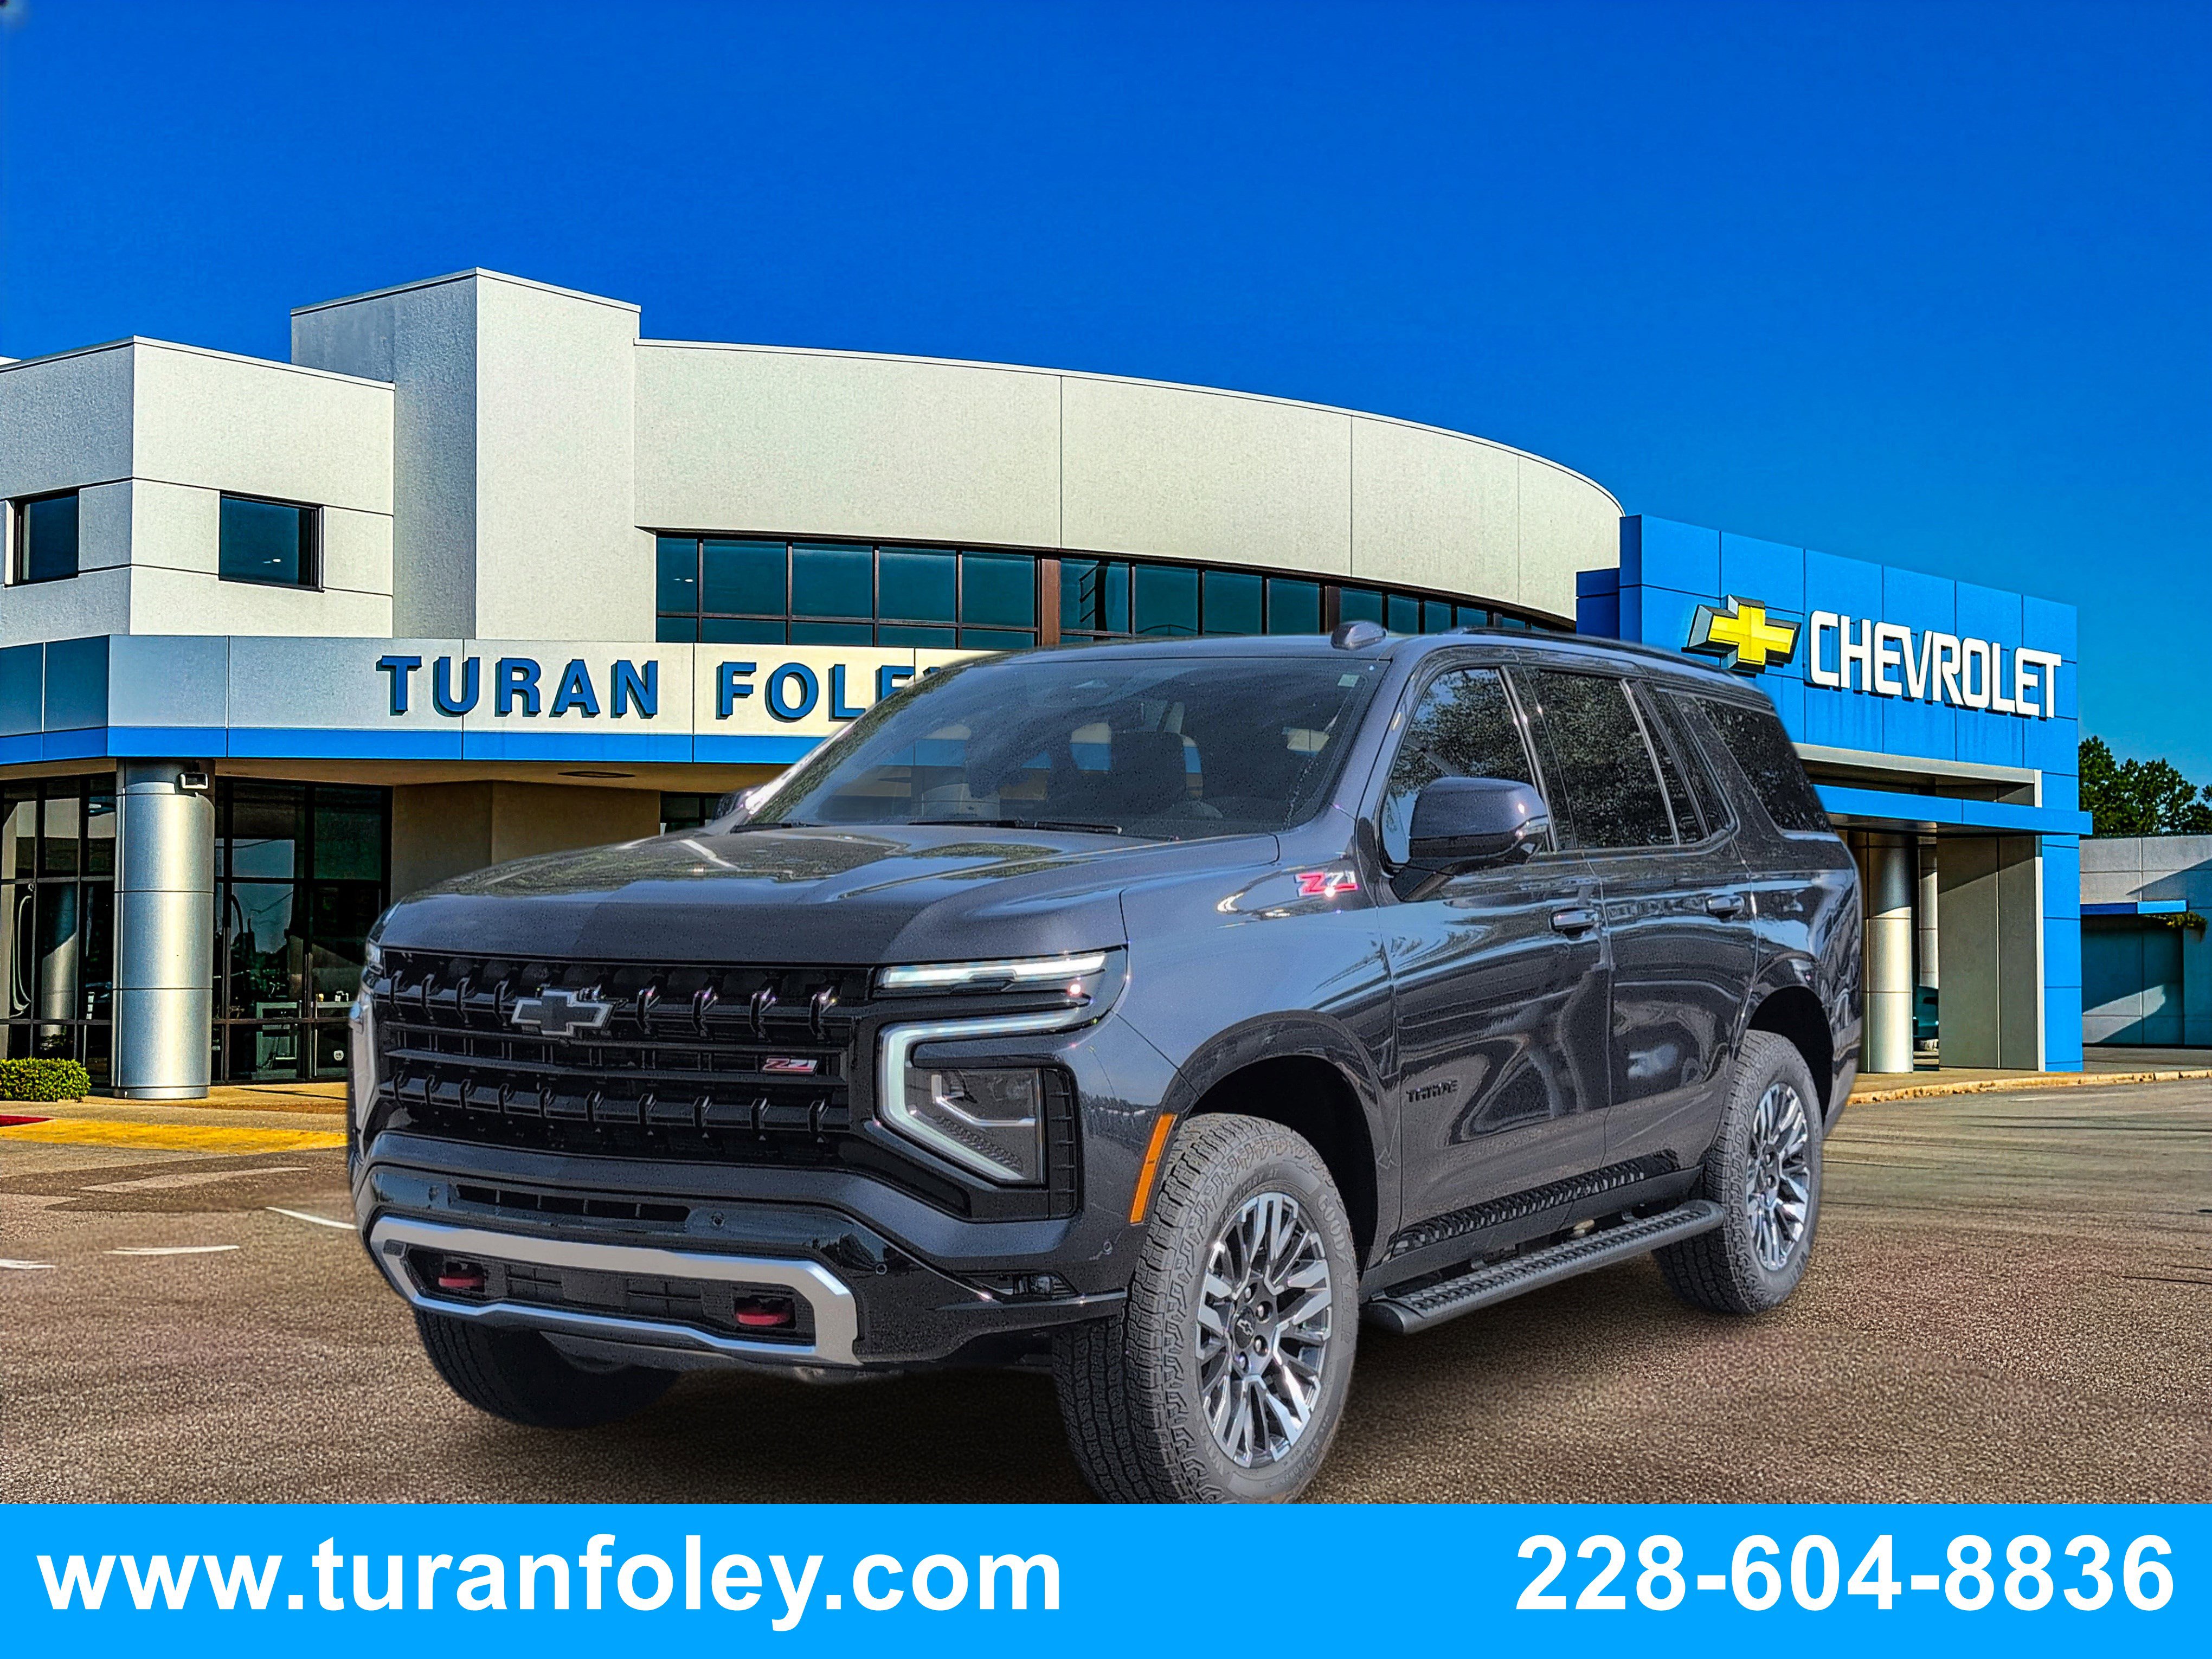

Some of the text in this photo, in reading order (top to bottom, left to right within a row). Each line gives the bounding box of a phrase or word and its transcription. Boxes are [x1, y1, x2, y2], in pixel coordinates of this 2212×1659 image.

[376, 654, 941, 723] TURAN FOLE
[1809, 609, 2062, 719] CHEVROLET
[1294, 869, 1360, 898] Z71
[762, 1057, 818, 1075] Z71
